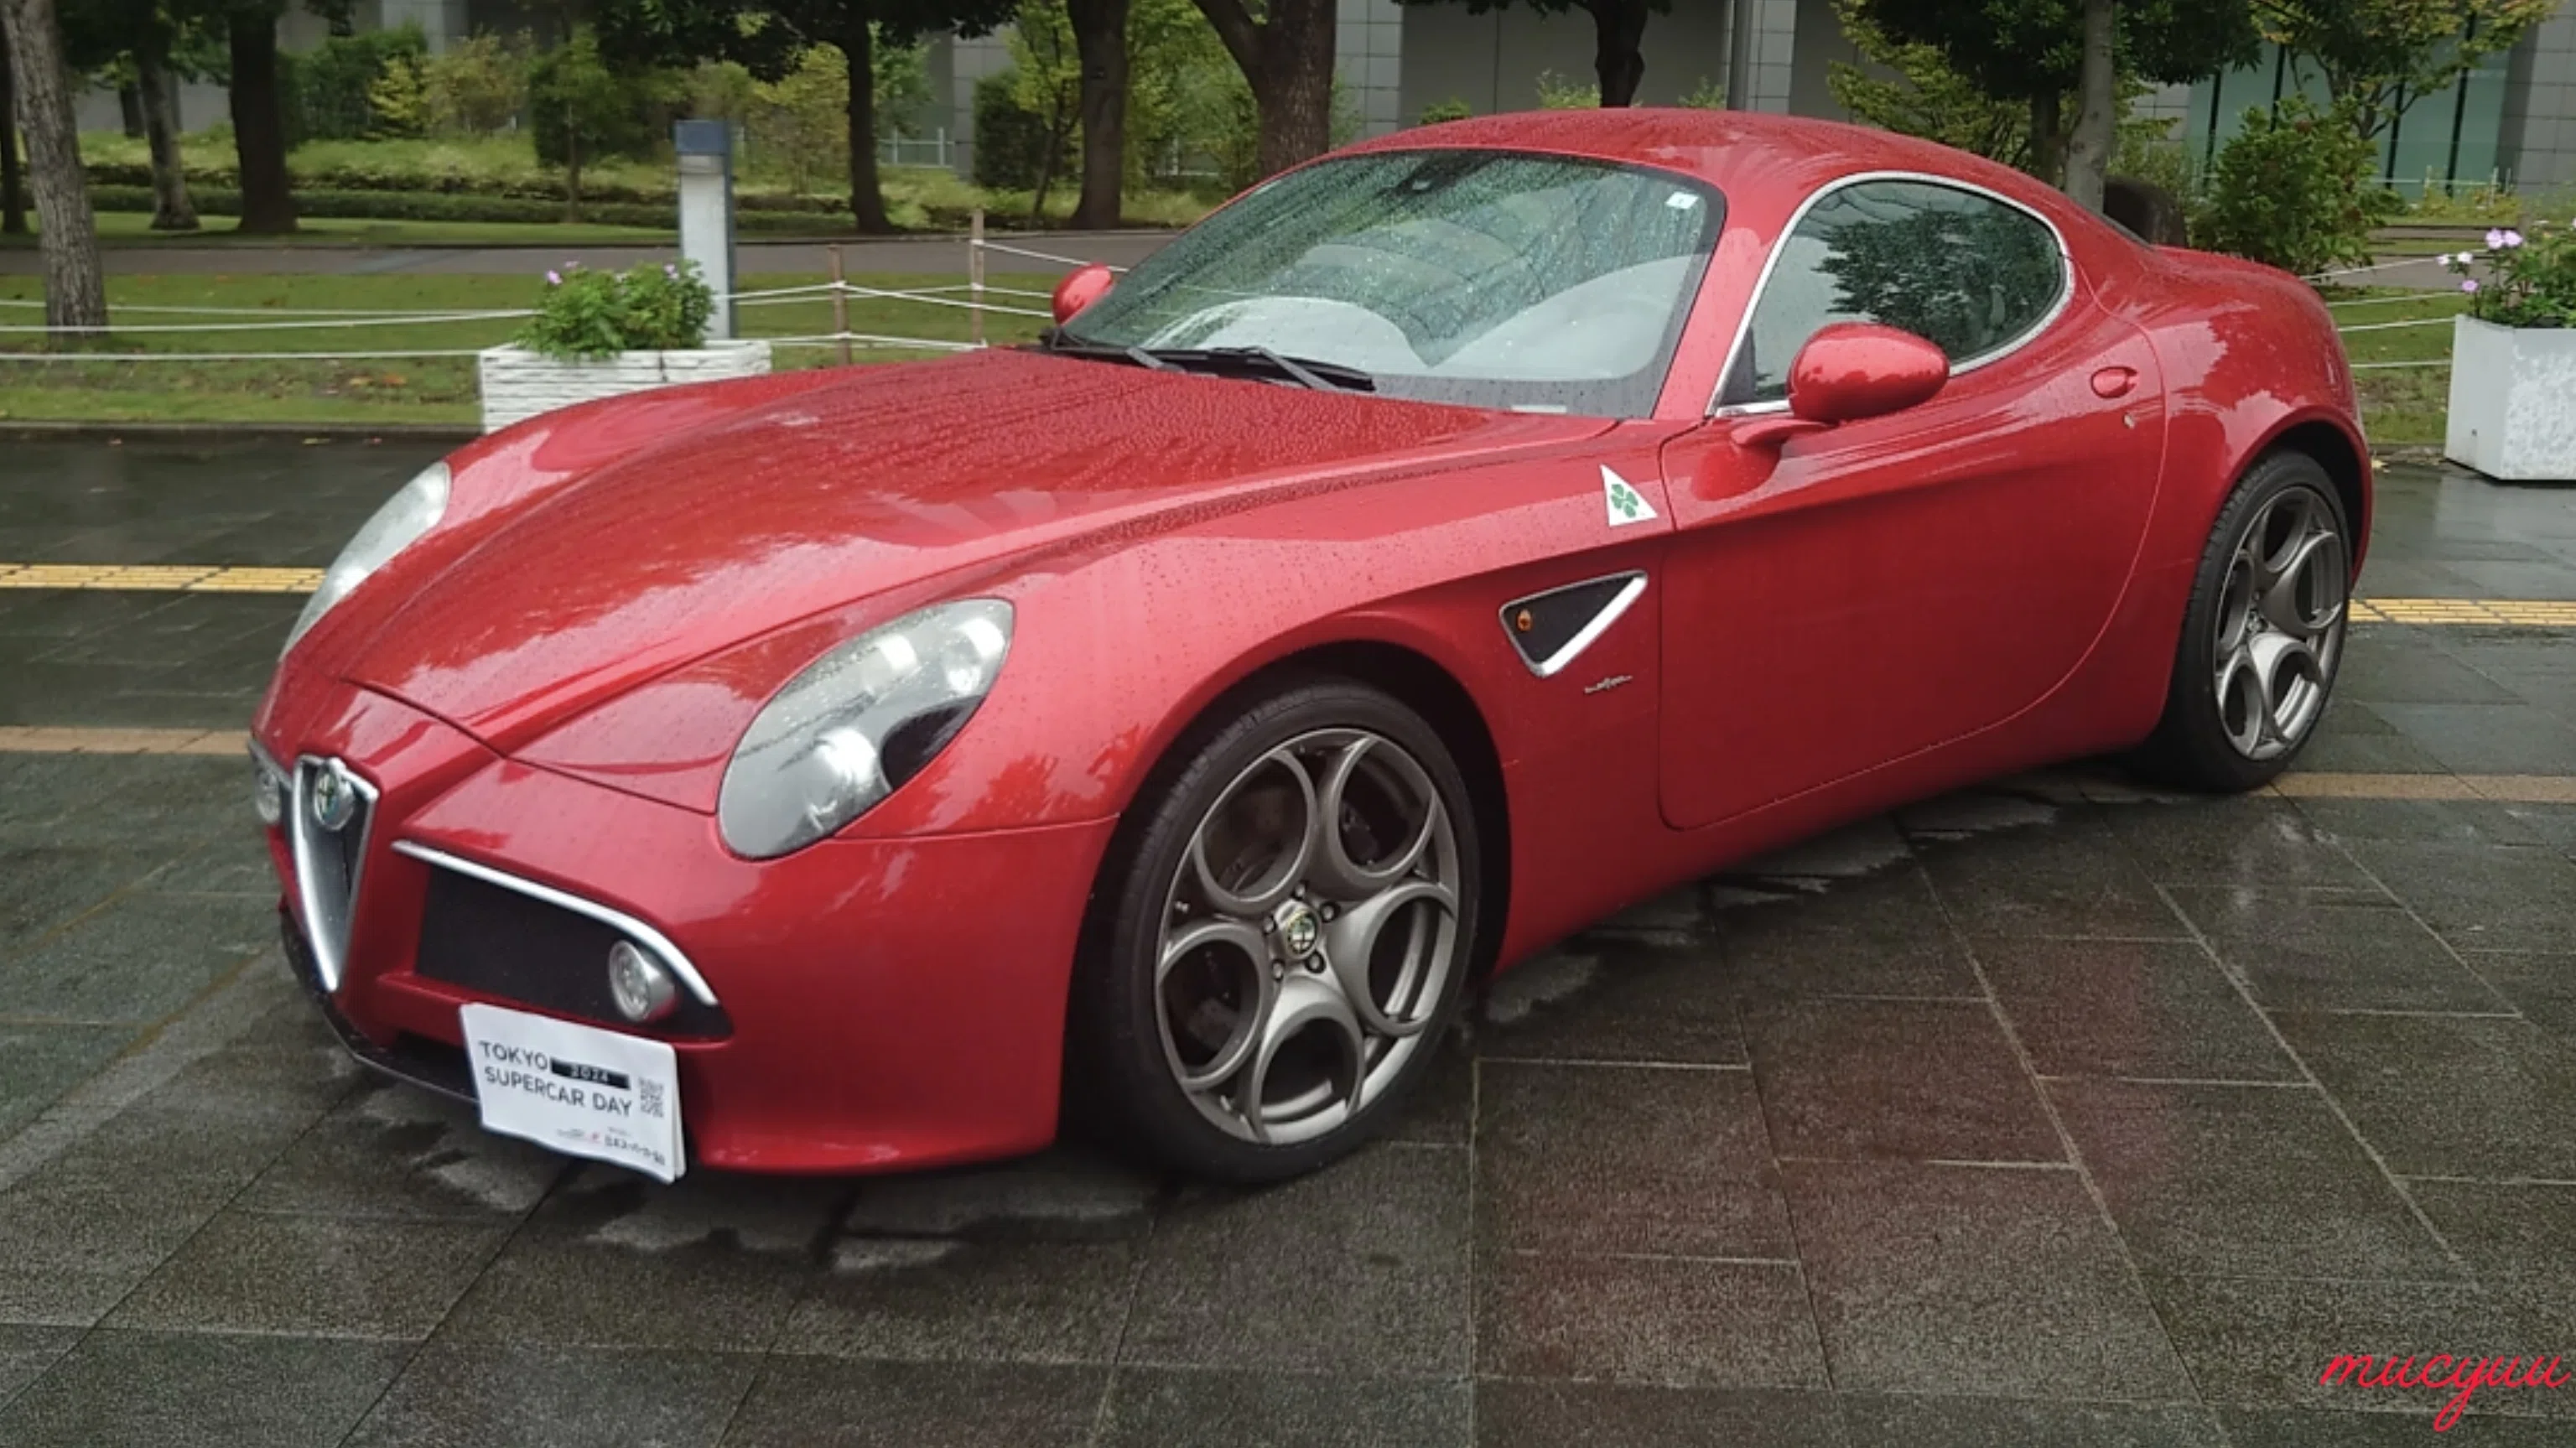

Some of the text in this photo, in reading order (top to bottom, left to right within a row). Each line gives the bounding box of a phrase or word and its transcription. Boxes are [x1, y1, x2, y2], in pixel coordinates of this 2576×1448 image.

[480, 1041, 610, 1082] TOKYO 2024
[485, 1067, 632, 1116] SUPERCAR DAY
